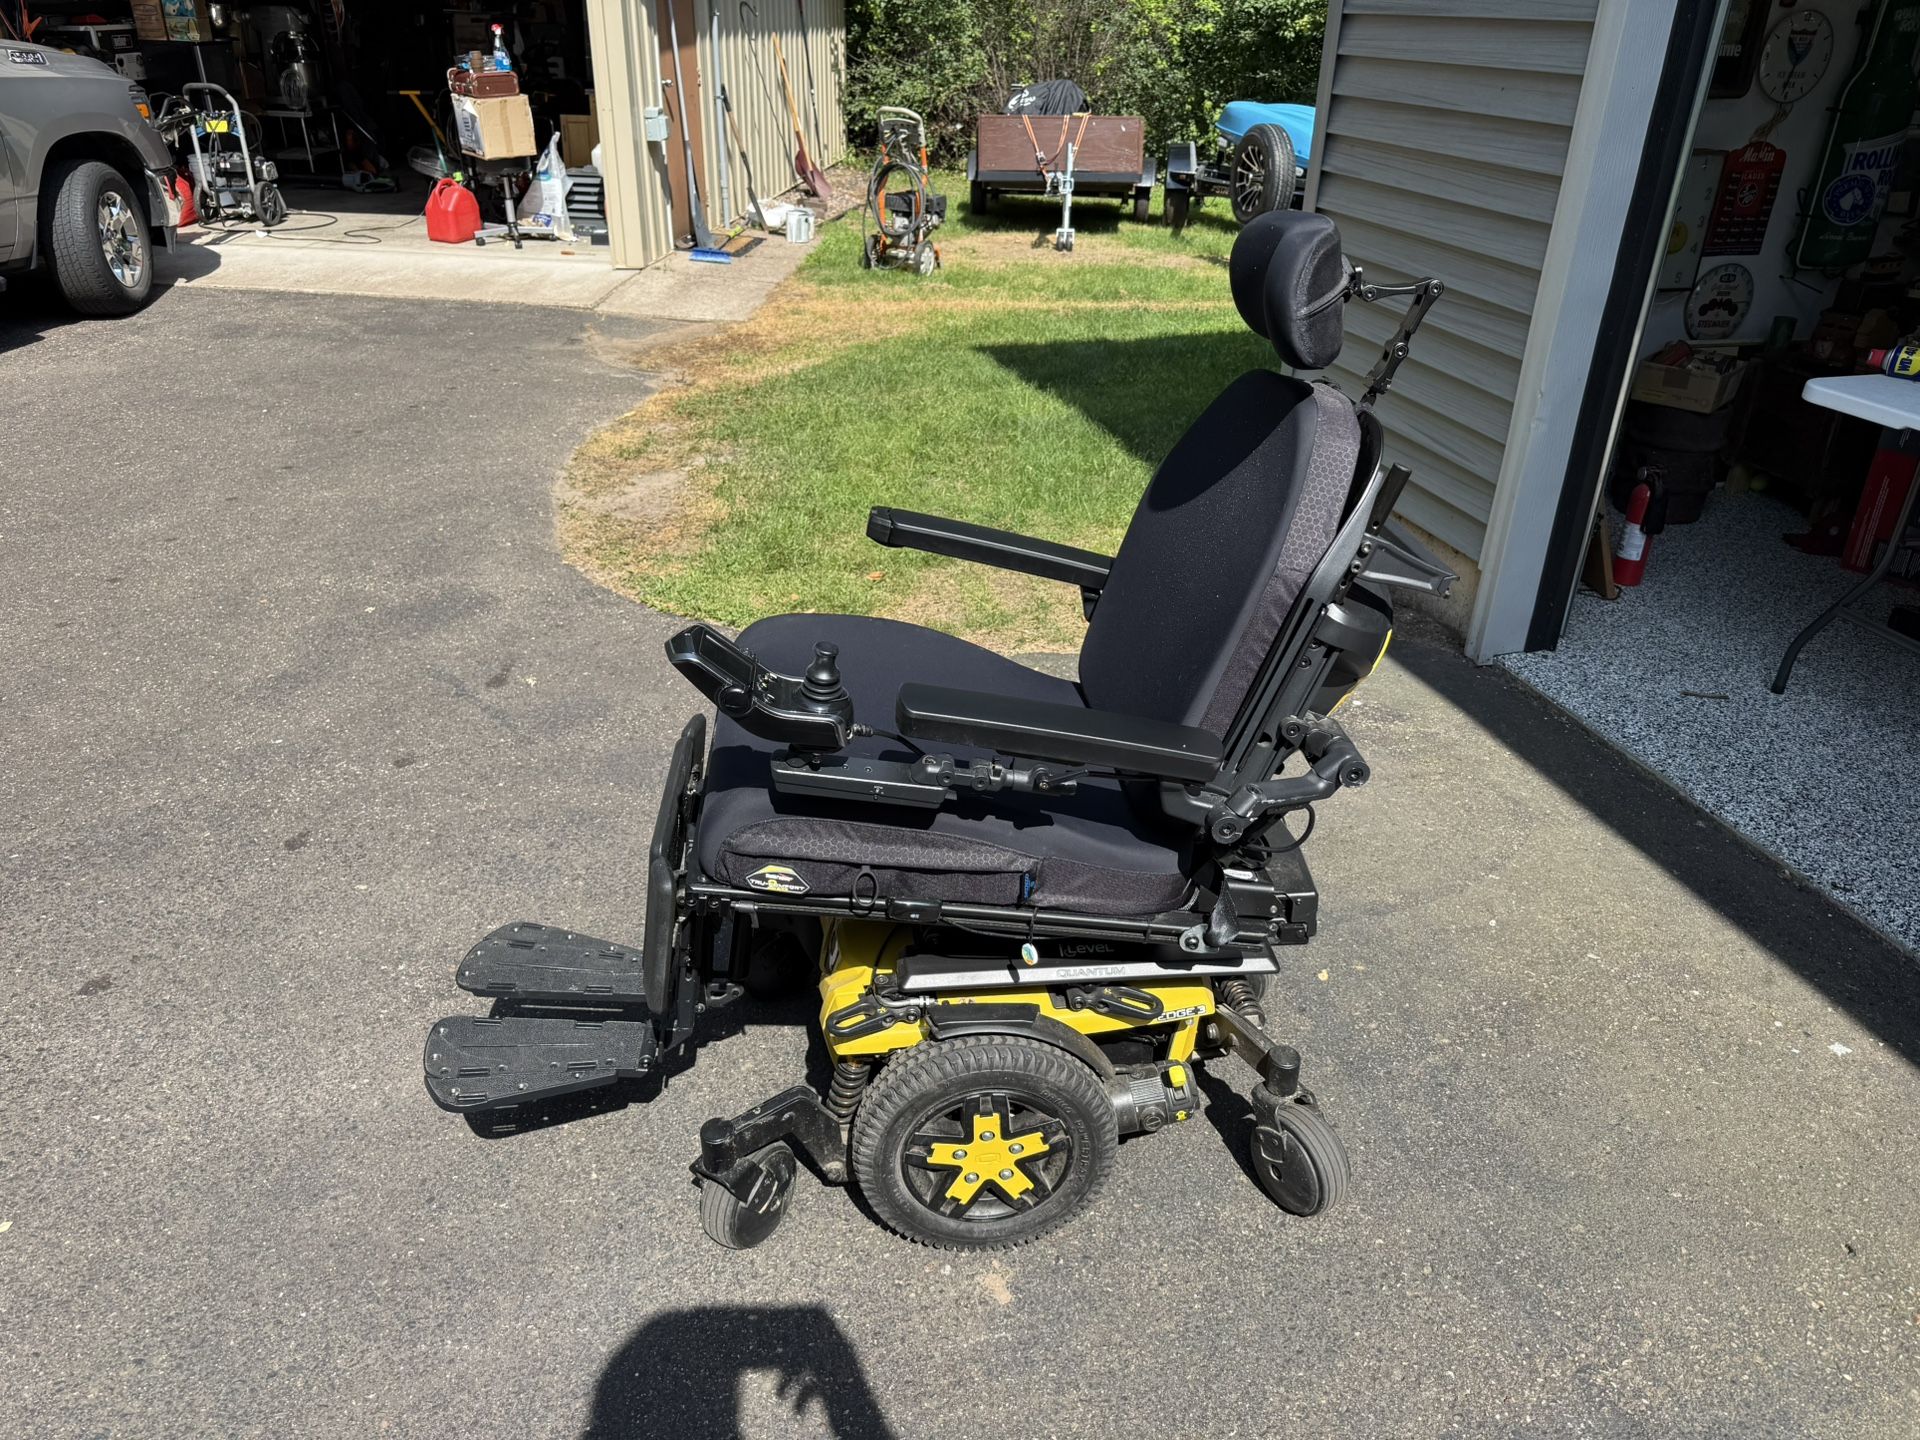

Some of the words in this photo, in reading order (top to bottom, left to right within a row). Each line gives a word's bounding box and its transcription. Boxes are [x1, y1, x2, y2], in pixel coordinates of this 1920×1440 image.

[1719, 40, 1742, 57] ime
[1897, 346, 1919, 371] WD-40
[749, 878, 805, 891] TRU-MFORT
[1056, 966, 1126, 978] QUANTUM
